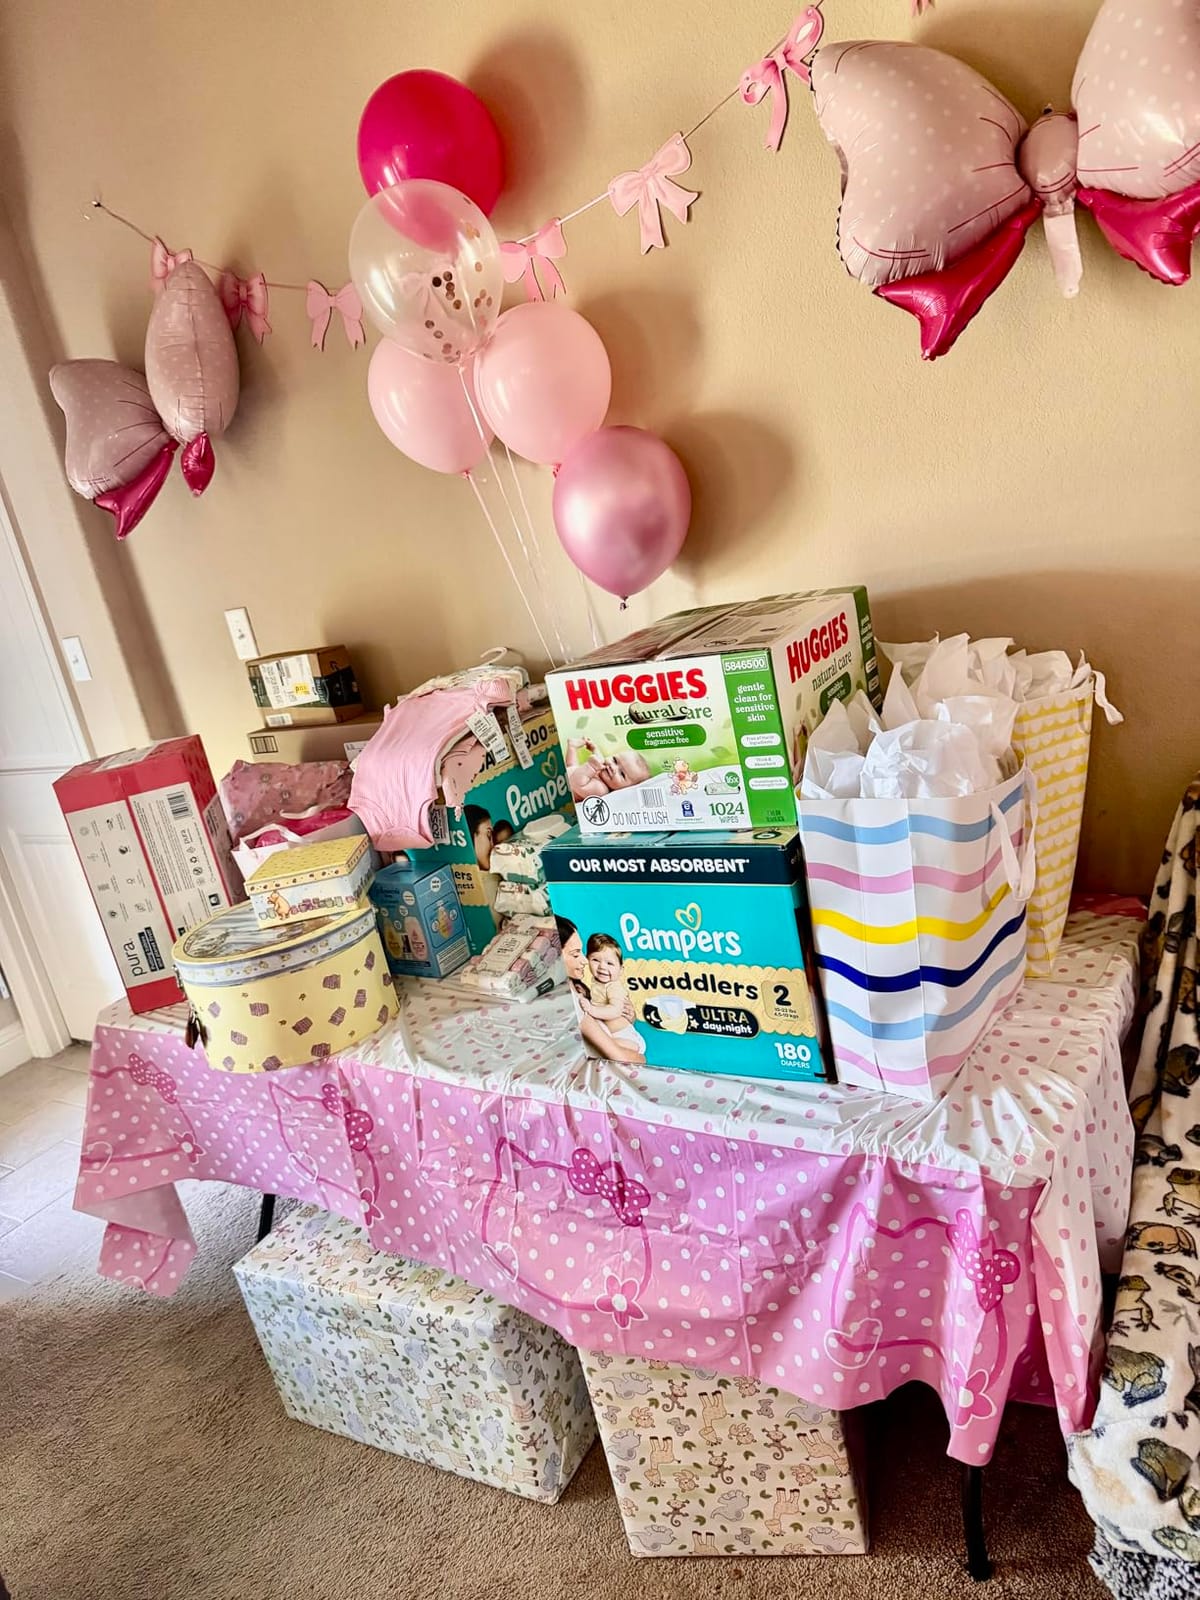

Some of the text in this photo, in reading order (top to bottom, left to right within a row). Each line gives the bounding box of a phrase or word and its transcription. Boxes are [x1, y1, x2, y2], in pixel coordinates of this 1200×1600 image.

[786, 611, 848, 683] HUGGIES
[812, 658, 837, 692] natural
[838, 651, 852, 670] care
[565, 668, 707, 711] HUGGIES
[737, 682, 765, 694] gentle
[734, 693, 772, 704] clean for
[613, 704, 713, 726] natural care
[735, 703, 775, 713] sensitive
[747, 714, 766, 722] skin
[646, 727, 684, 739] sensitive
[644, 736, 689, 747] fragrance free
[505, 775, 568, 826] Pampe
[709, 801, 744, 816] 1024
[612, 813, 624, 825] DO
[625, 812, 641, 825] NOT
[643, 811, 669, 824] FLUSH
[719, 815, 739, 824] WIPES
[569, 858, 601, 872] OUR
[603, 858, 646, 873] MOST
[619, 912, 742, 959] Pampers
[123, 938, 148, 976] pura
[626, 972, 759, 1000] swaddlers
[773, 984, 792, 1007] 2
[700, 1007, 750, 1024] ULTRA
[774, 1042, 812, 1062] 180
[780, 1059, 810, 1069] DIAPERS
